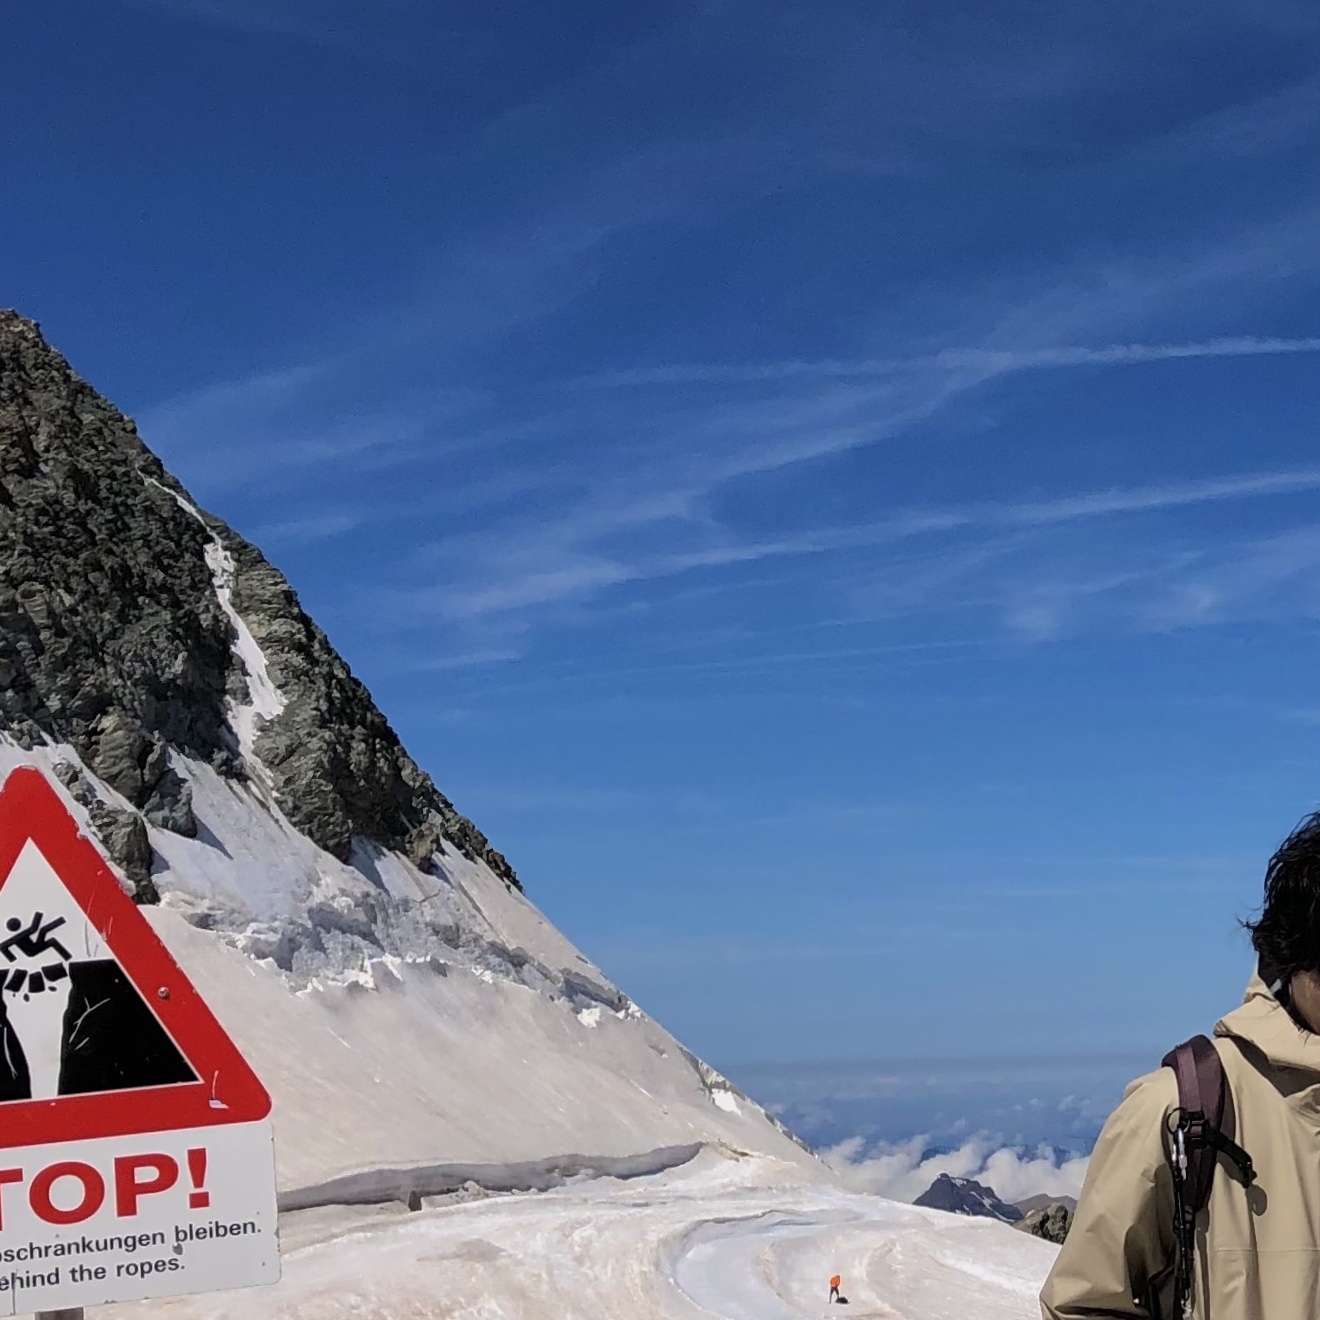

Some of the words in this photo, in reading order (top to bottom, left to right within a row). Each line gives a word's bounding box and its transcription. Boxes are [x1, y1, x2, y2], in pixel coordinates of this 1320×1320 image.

[0, 1231, 165, 1264] schrankungen
[175, 1220, 262, 1243] bleiben.
[0, 1268, 59, 1291] ehind
[69, 1264, 107, 1283] the
[116, 1257, 186, 1280] ropes.
